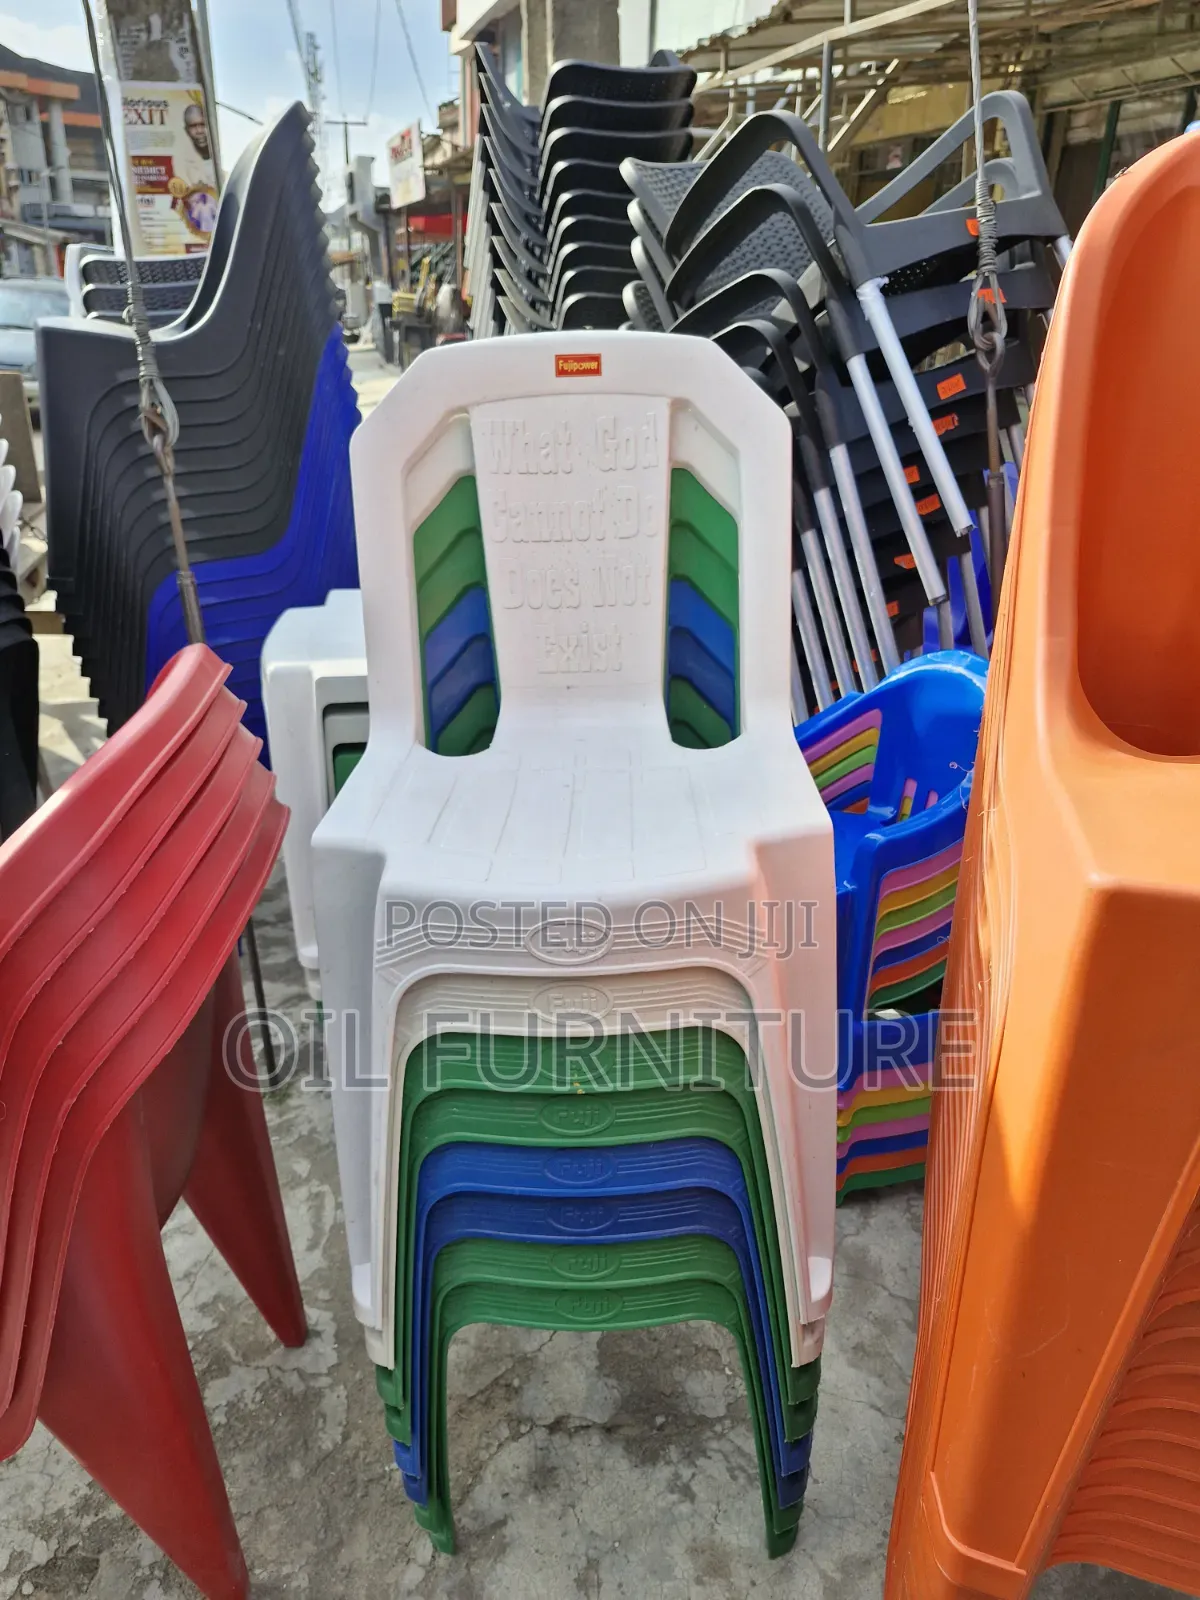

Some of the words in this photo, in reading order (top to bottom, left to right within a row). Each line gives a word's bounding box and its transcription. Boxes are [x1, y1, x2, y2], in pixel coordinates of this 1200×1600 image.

[558, 360, 599, 372] Fujipower
[483, 419, 573, 475] What
[596, 412, 659, 472] God
[488, 487, 606, 543] Cannot
[500, 557, 581, 609] Does
[592, 554, 652, 609] Not
[534, 621, 623, 674] Exist
